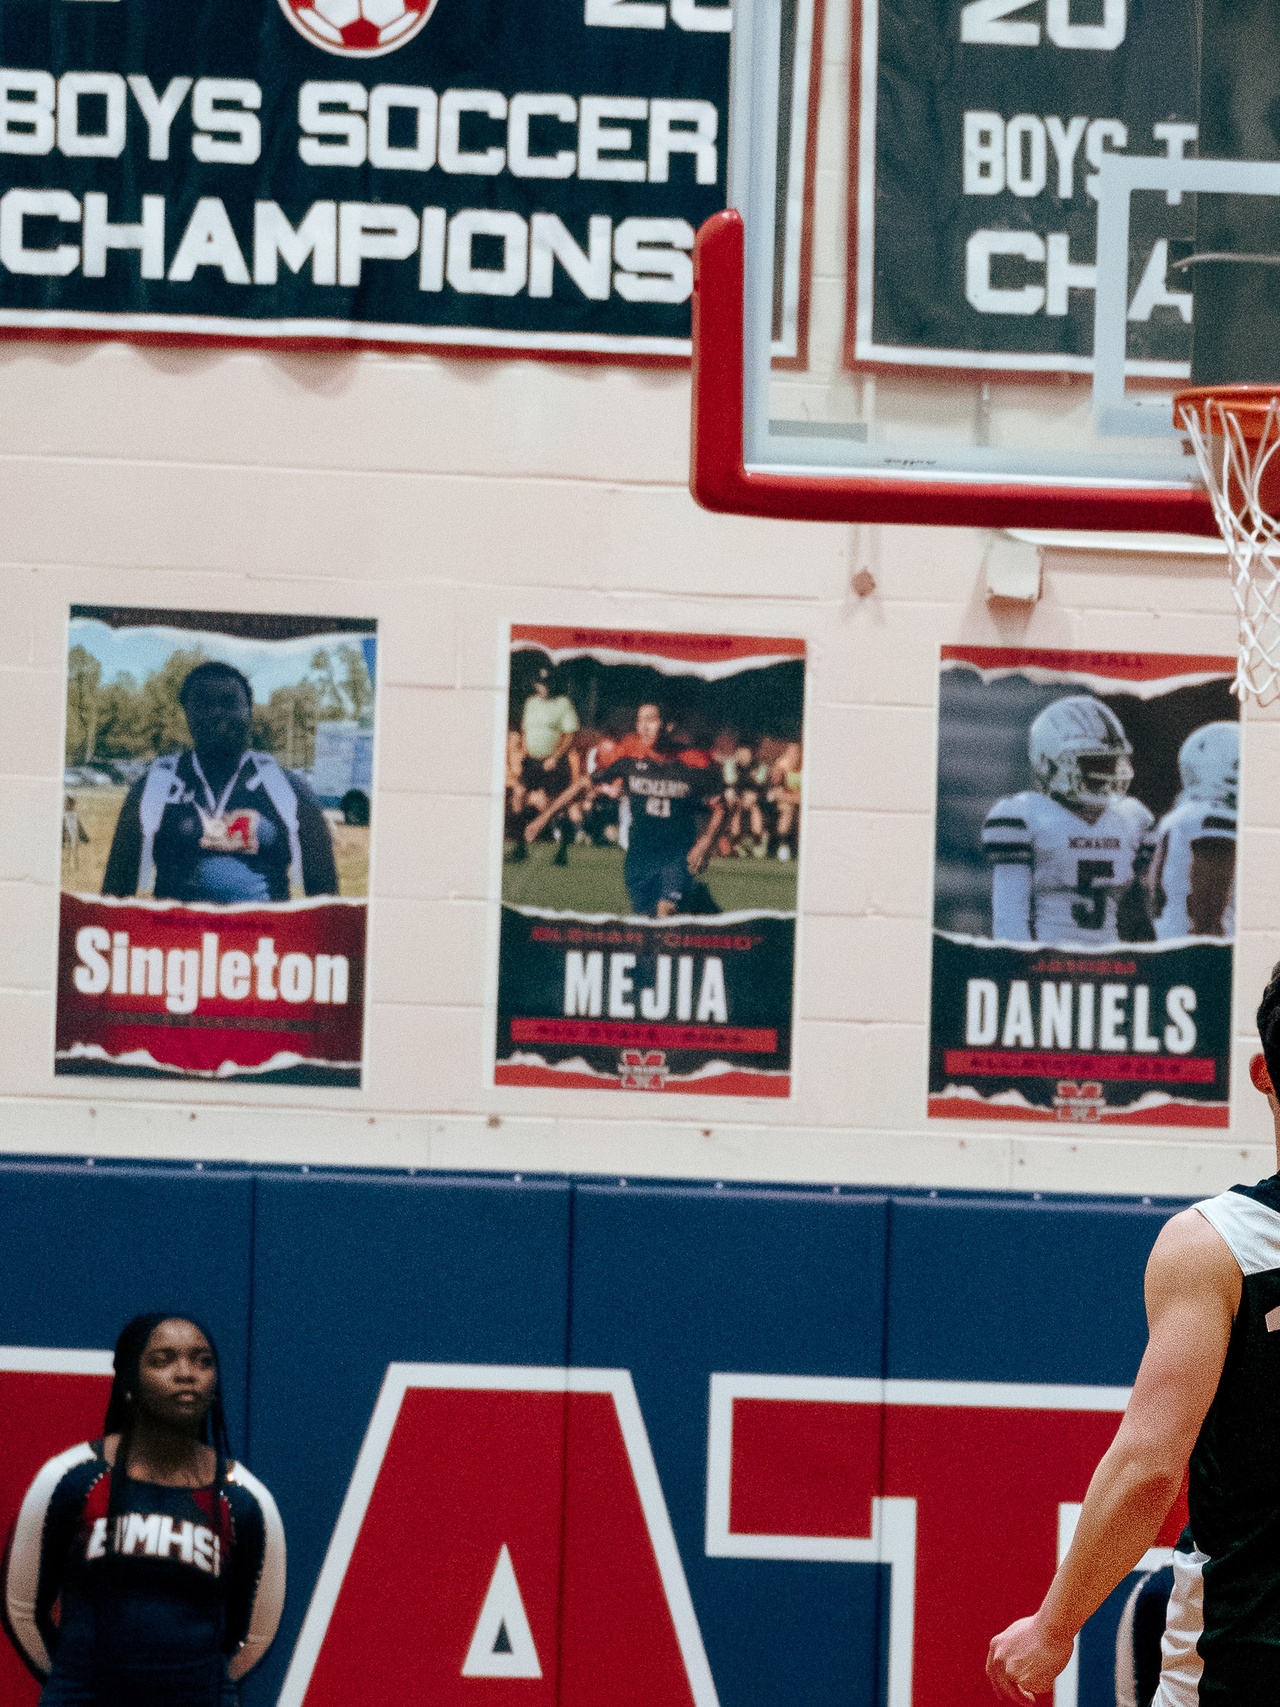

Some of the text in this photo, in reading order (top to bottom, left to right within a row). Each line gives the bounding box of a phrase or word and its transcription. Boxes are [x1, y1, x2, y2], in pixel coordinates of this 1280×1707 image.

[0, 68, 717, 185] BOYS SOCCER
[963, 110, 1127, 201] BOYS
[1, 188, 695, 304] CHAMPIONS
[74, 926, 350, 1015] Singleton
[563, 950, 728, 1023] MEJIA
[965, 977, 1198, 1054] DANIELS
